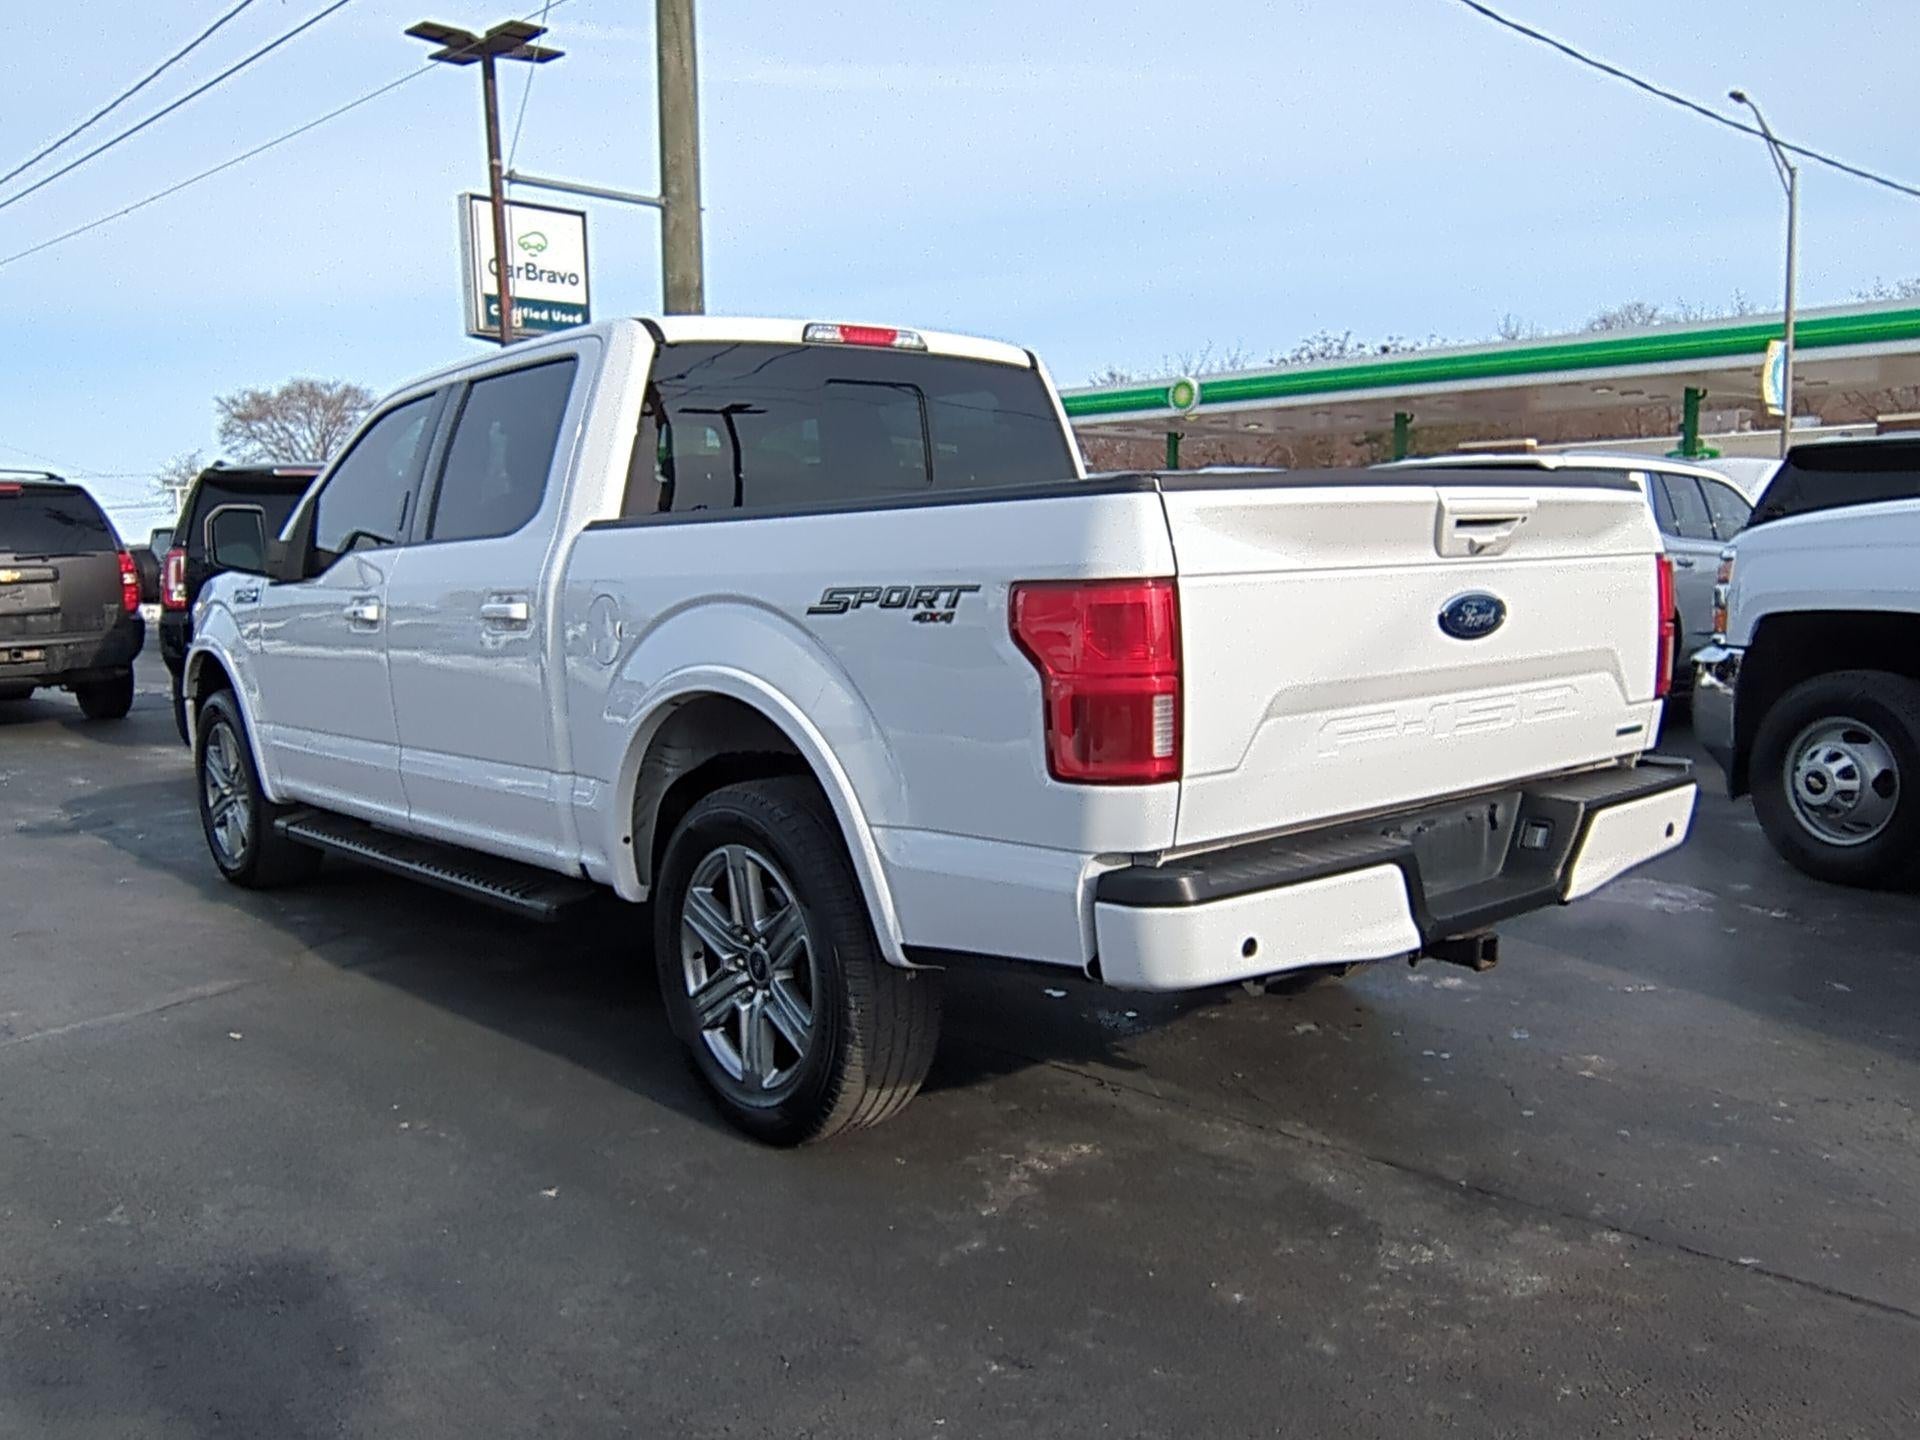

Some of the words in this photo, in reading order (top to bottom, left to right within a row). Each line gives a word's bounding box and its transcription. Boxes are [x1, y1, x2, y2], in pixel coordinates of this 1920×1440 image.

[551, 310, 582, 323] Used
[806, 585, 981, 615] SPORT
[1458, 600, 1496, 628] Ford
